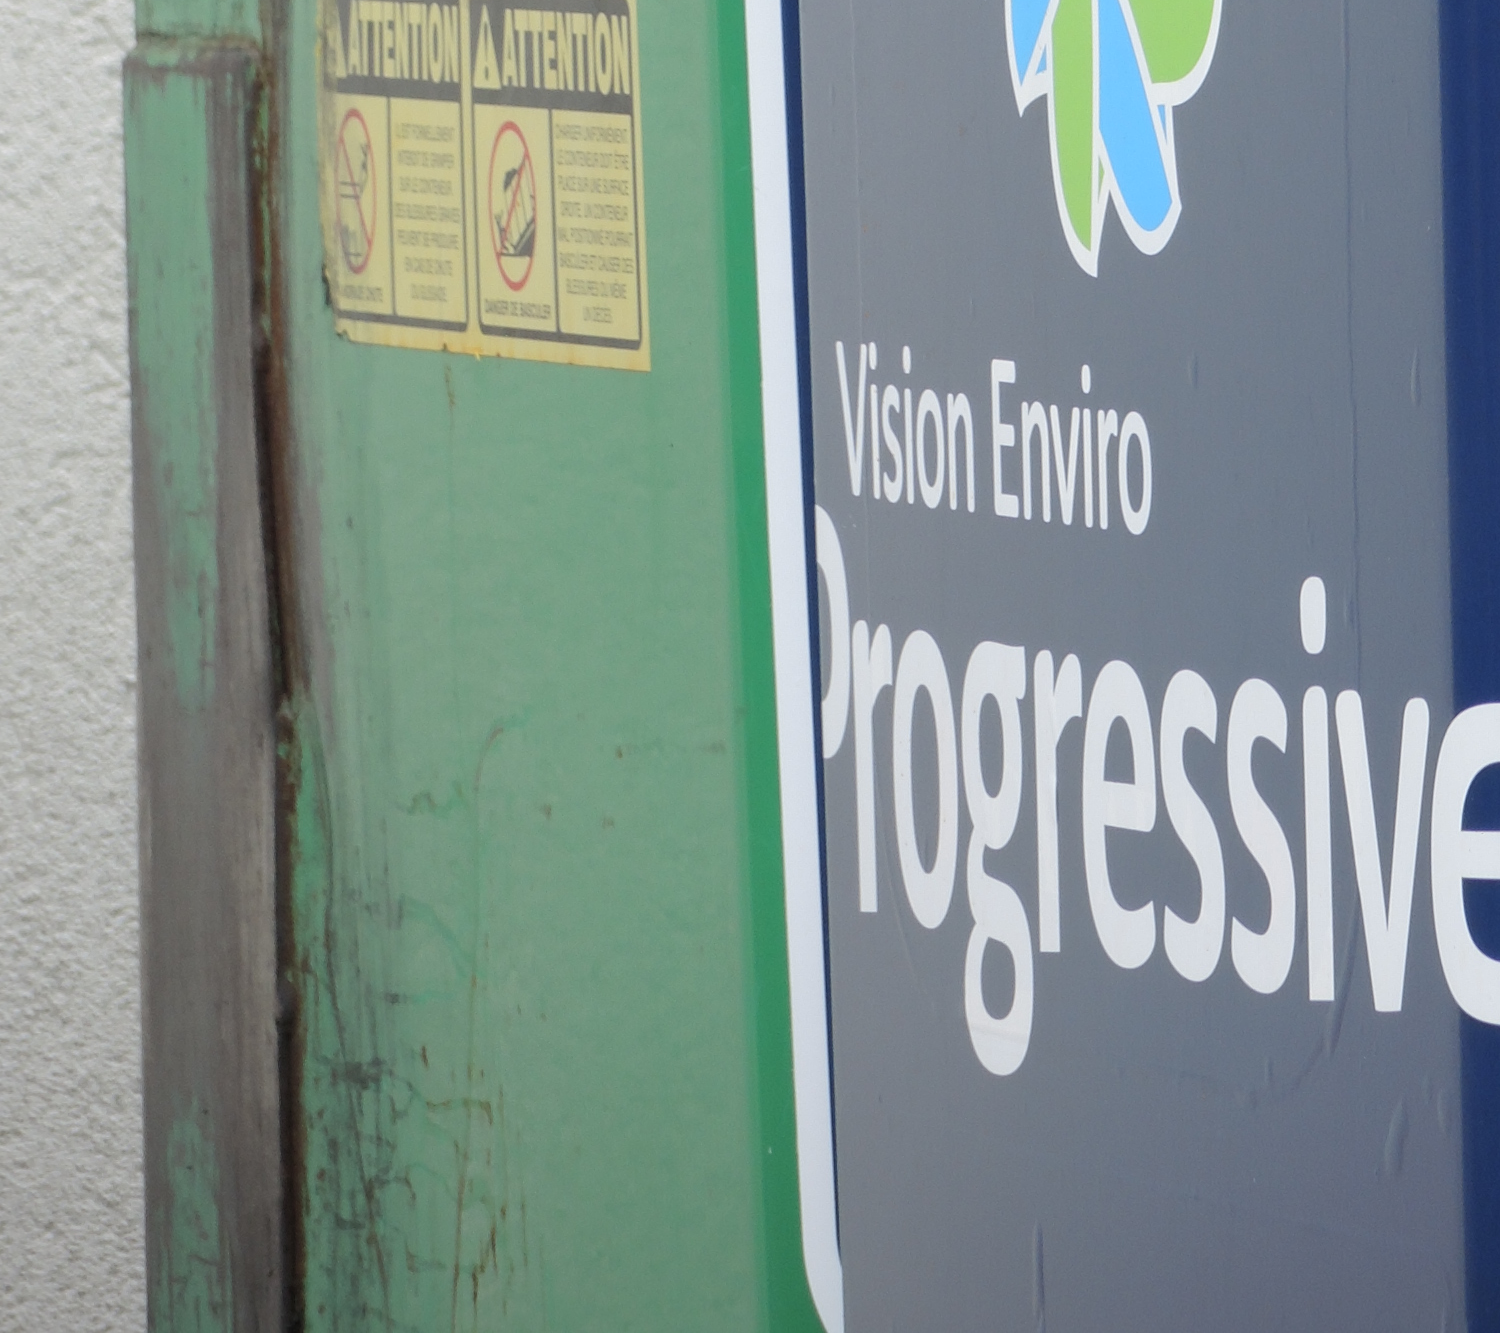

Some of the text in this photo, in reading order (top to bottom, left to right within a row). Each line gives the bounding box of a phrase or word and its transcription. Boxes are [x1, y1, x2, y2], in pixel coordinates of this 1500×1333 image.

[502, 8, 631, 95] ATTENTION
[836, 341, 1153, 535] Vision Enviro
